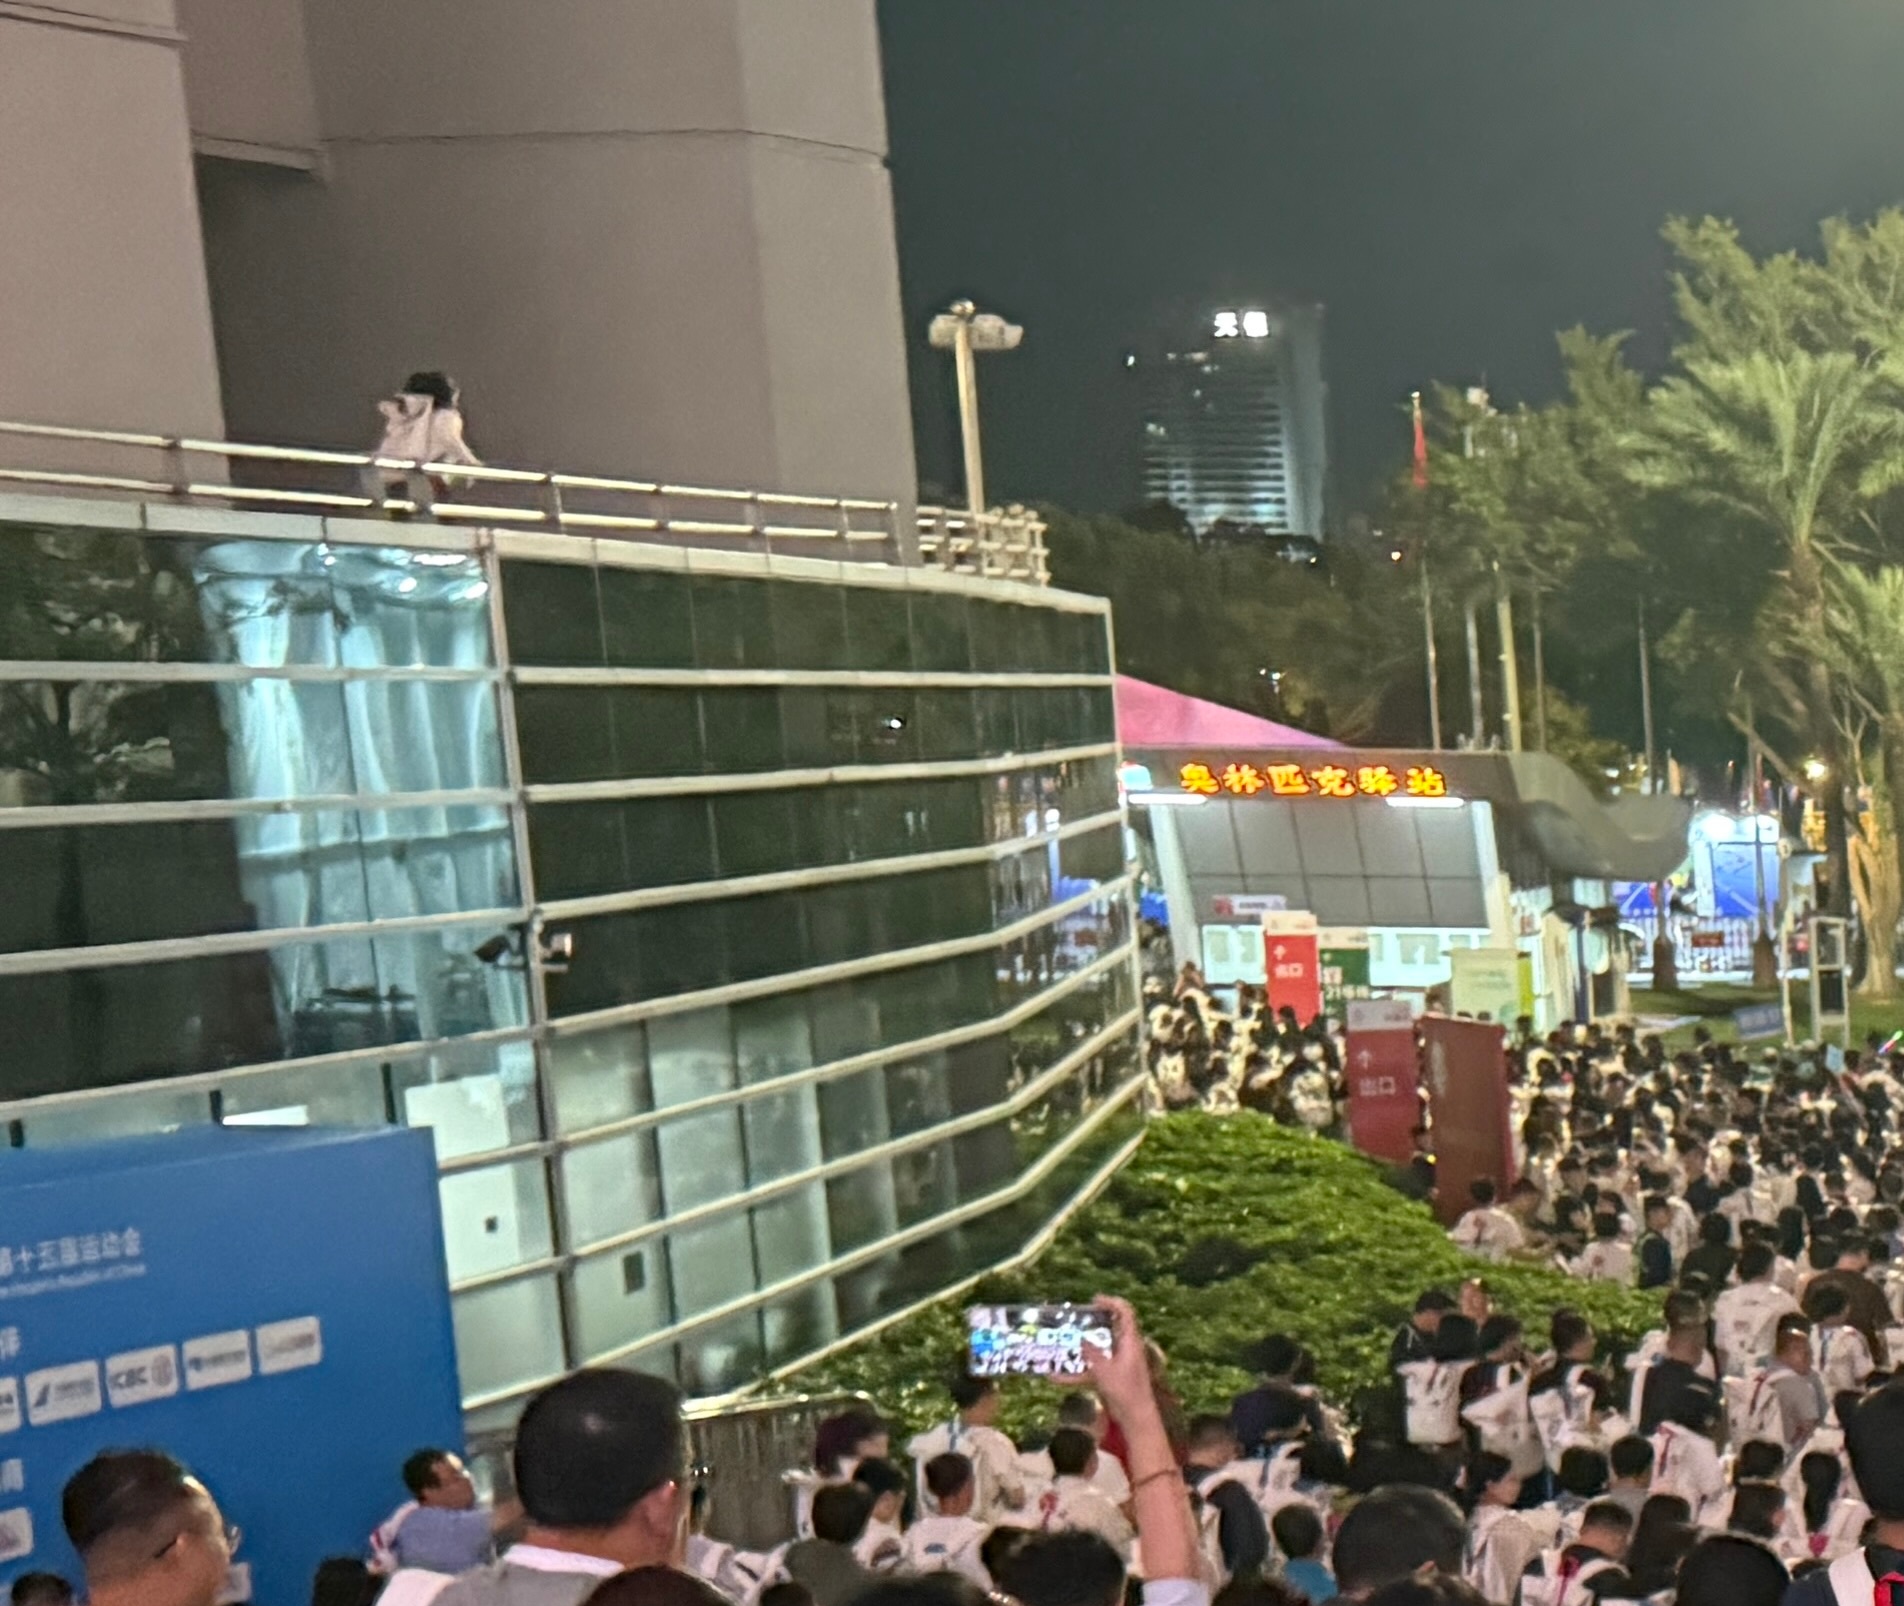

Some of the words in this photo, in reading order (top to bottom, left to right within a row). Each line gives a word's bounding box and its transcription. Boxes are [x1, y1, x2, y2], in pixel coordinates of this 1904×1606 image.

[1179, 762, 1446, 797] 奥林匹克驿站
[1359, 1076, 1396, 1096] 出口
